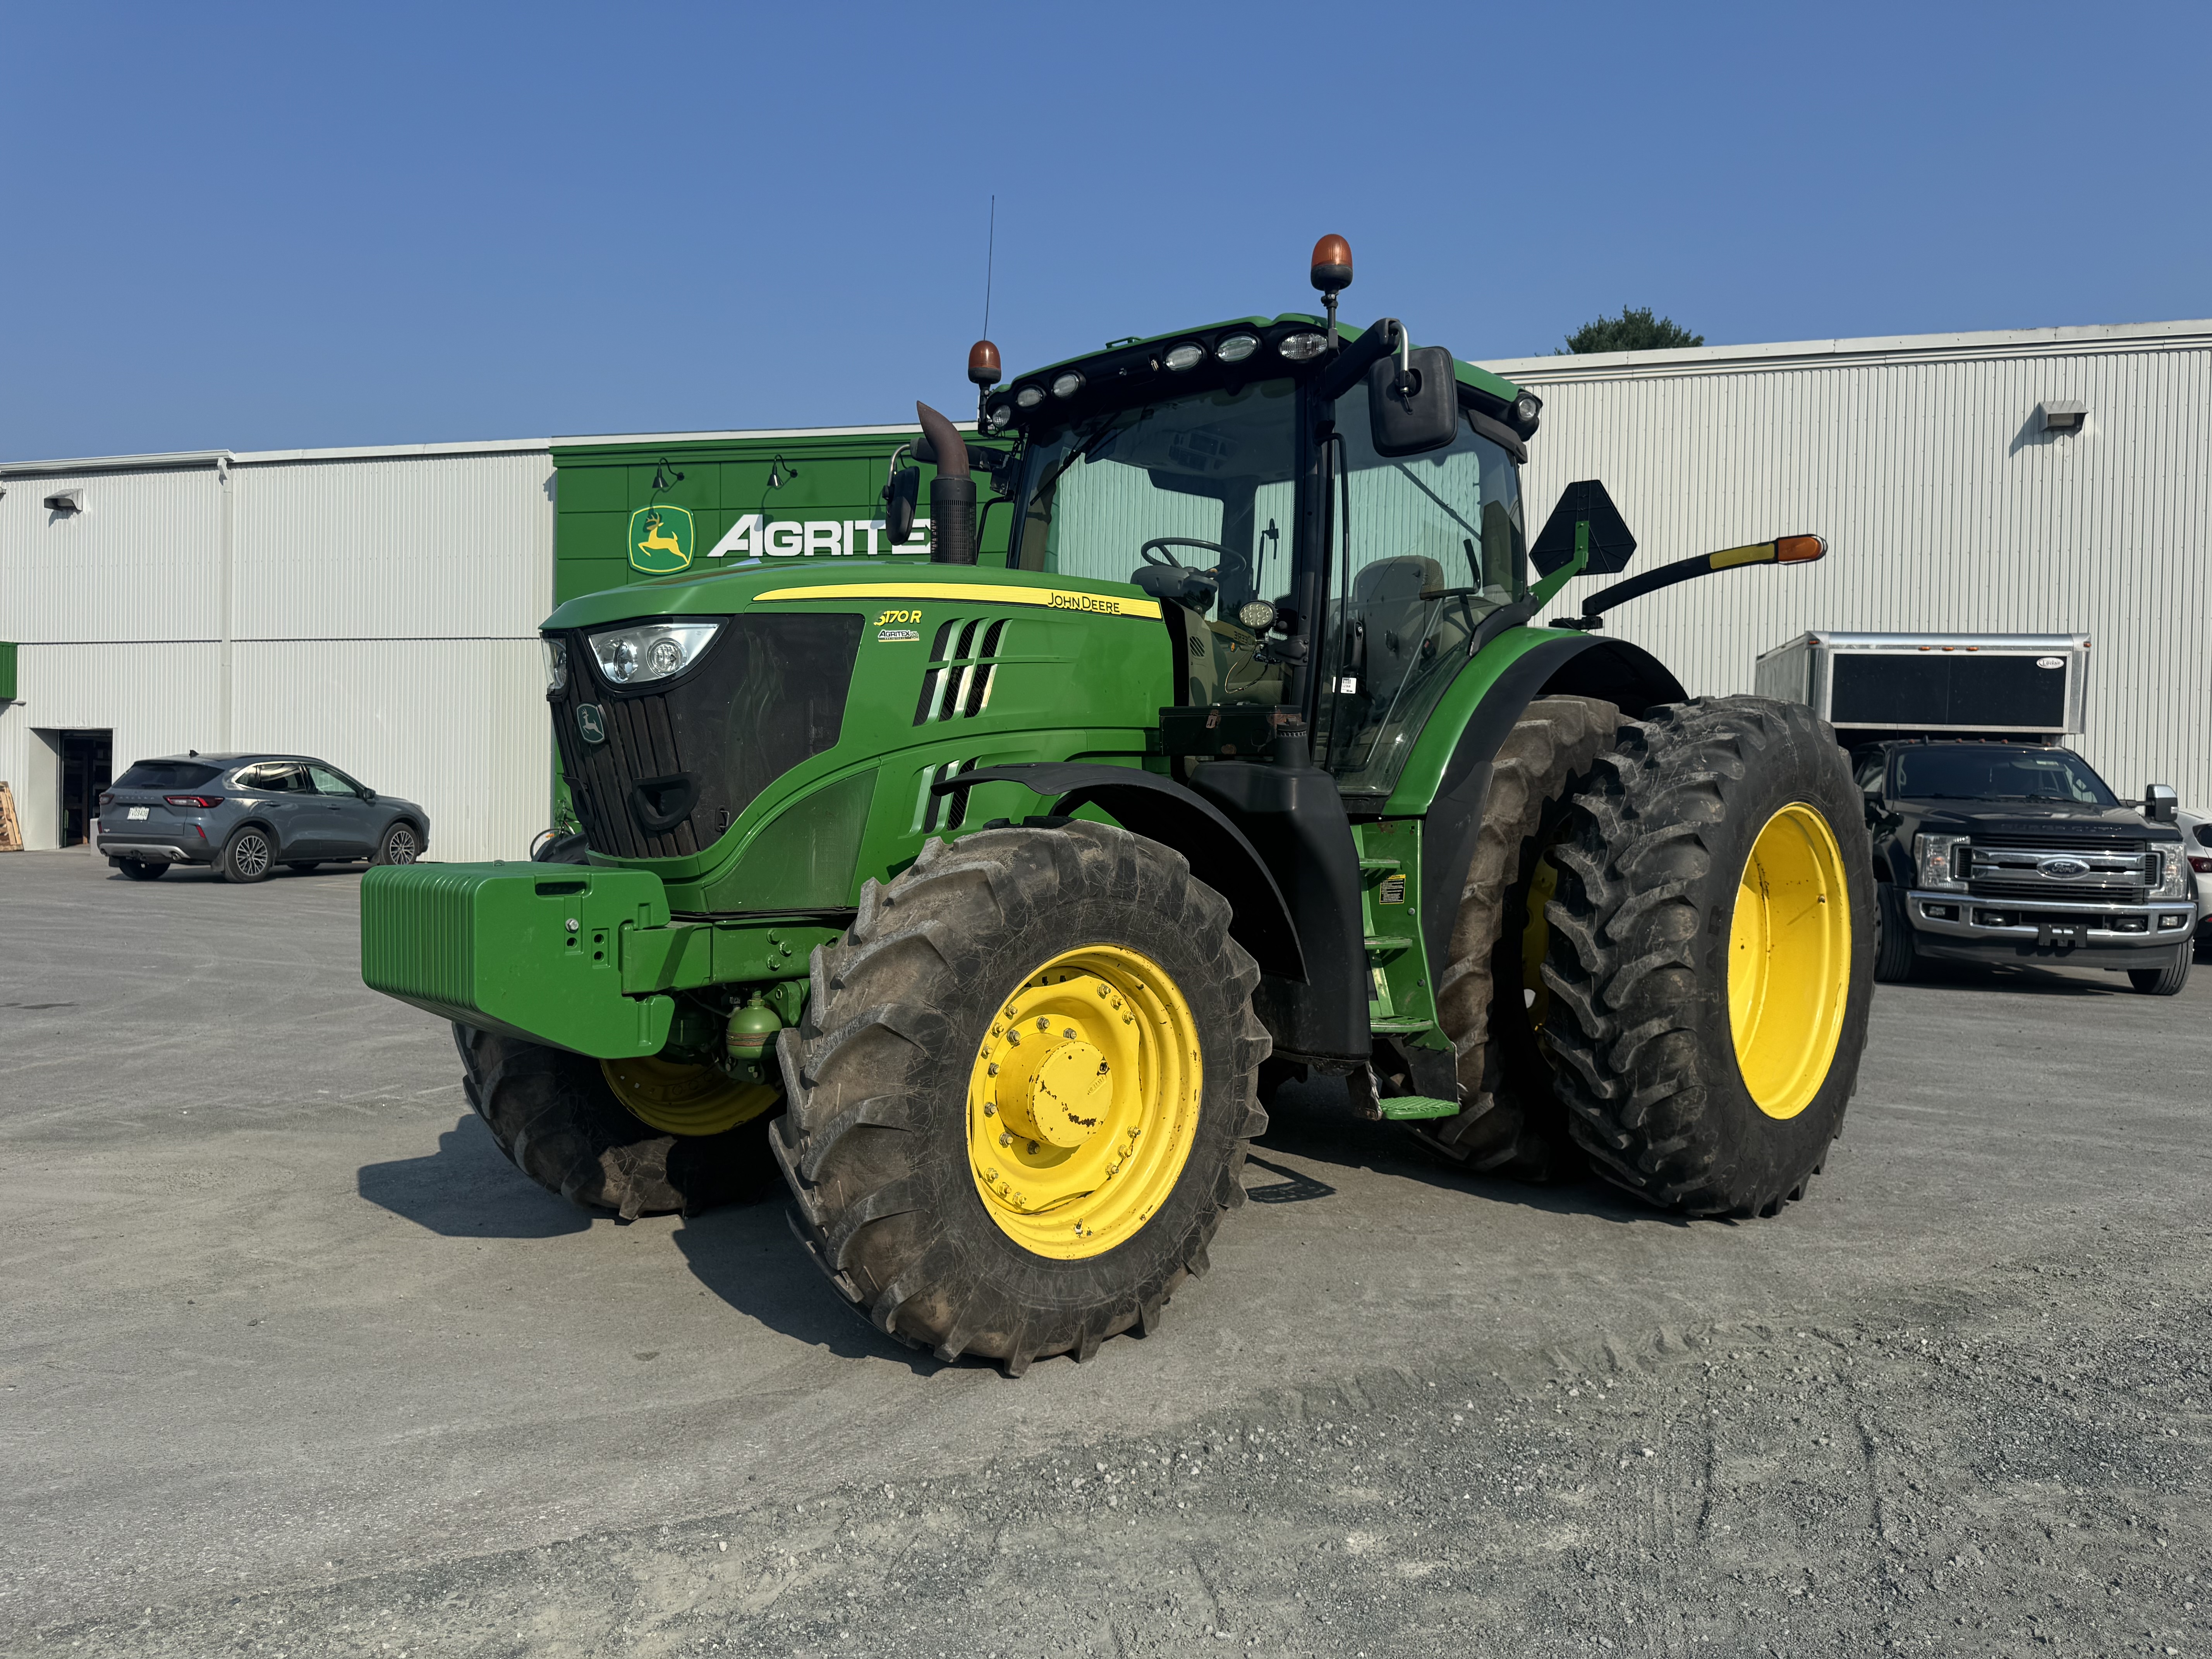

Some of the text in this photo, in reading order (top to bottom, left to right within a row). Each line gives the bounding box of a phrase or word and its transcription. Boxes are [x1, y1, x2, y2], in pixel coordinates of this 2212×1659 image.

[707, 514, 931, 557] AGRITE
[1048, 592, 1120, 613] JOHN DEERE
[2052, 862, 2076, 873] Ford
